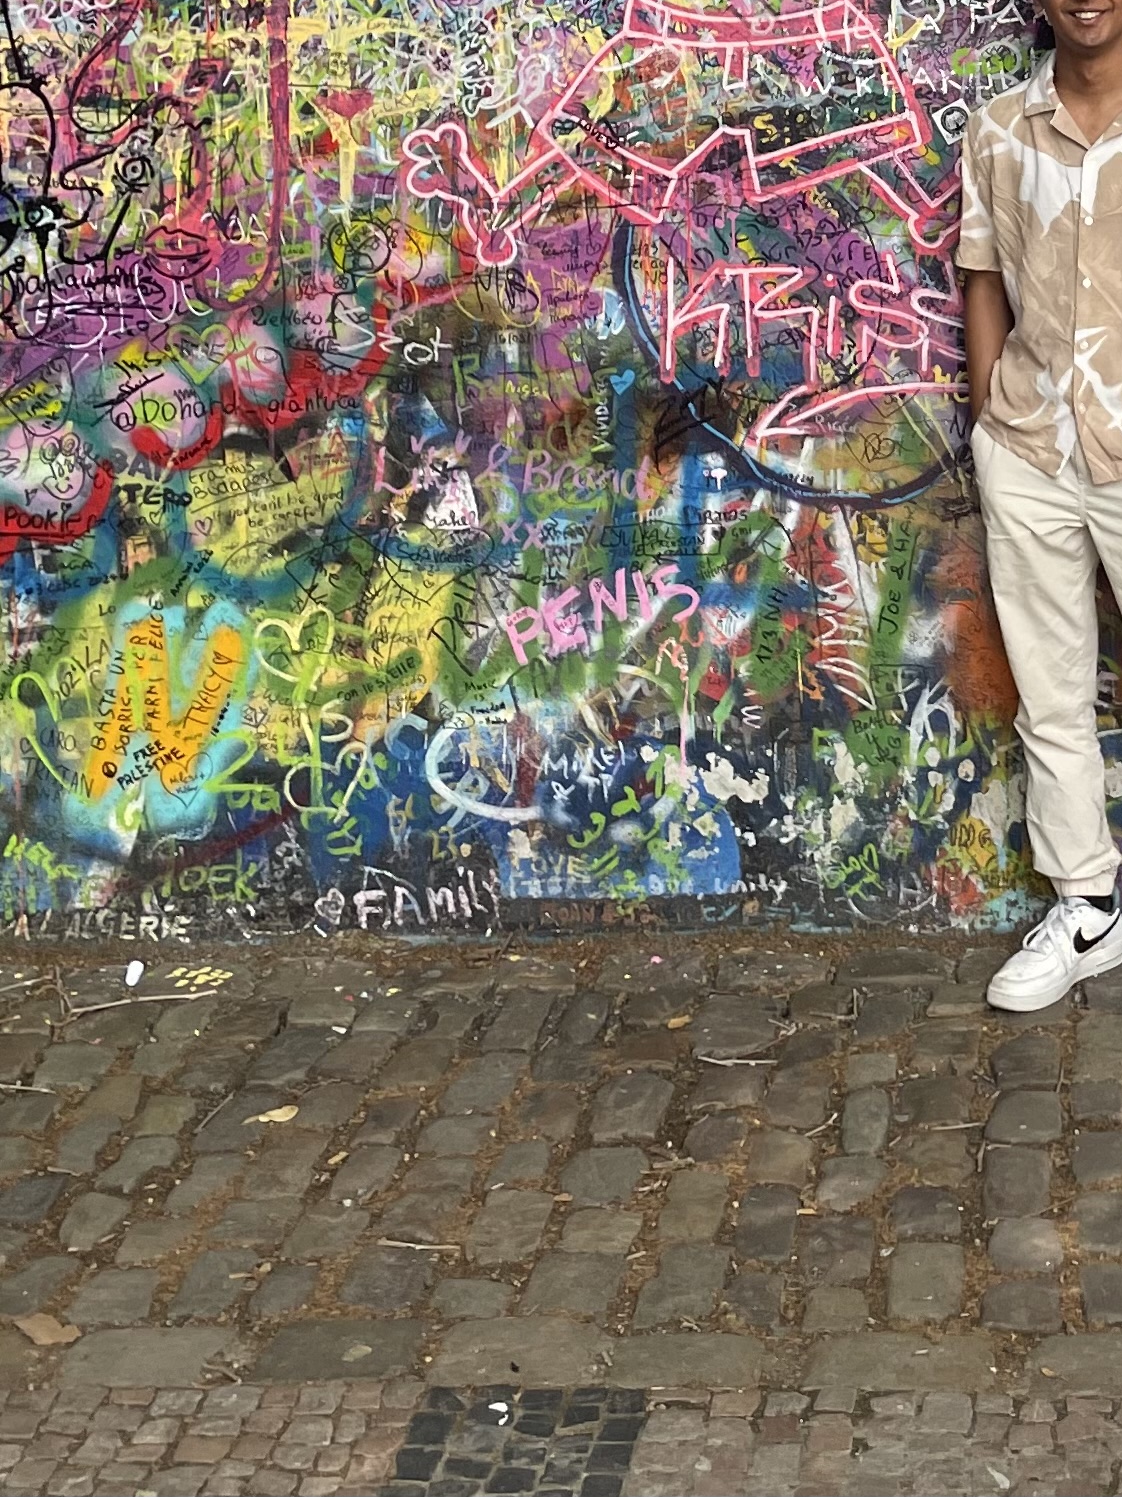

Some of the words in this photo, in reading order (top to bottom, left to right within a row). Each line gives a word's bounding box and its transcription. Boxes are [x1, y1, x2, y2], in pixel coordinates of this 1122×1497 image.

[504, 563, 700, 666] PENIS
[117, 748, 185, 790] PALESTINE
[132, 739, 166, 761] FREE
